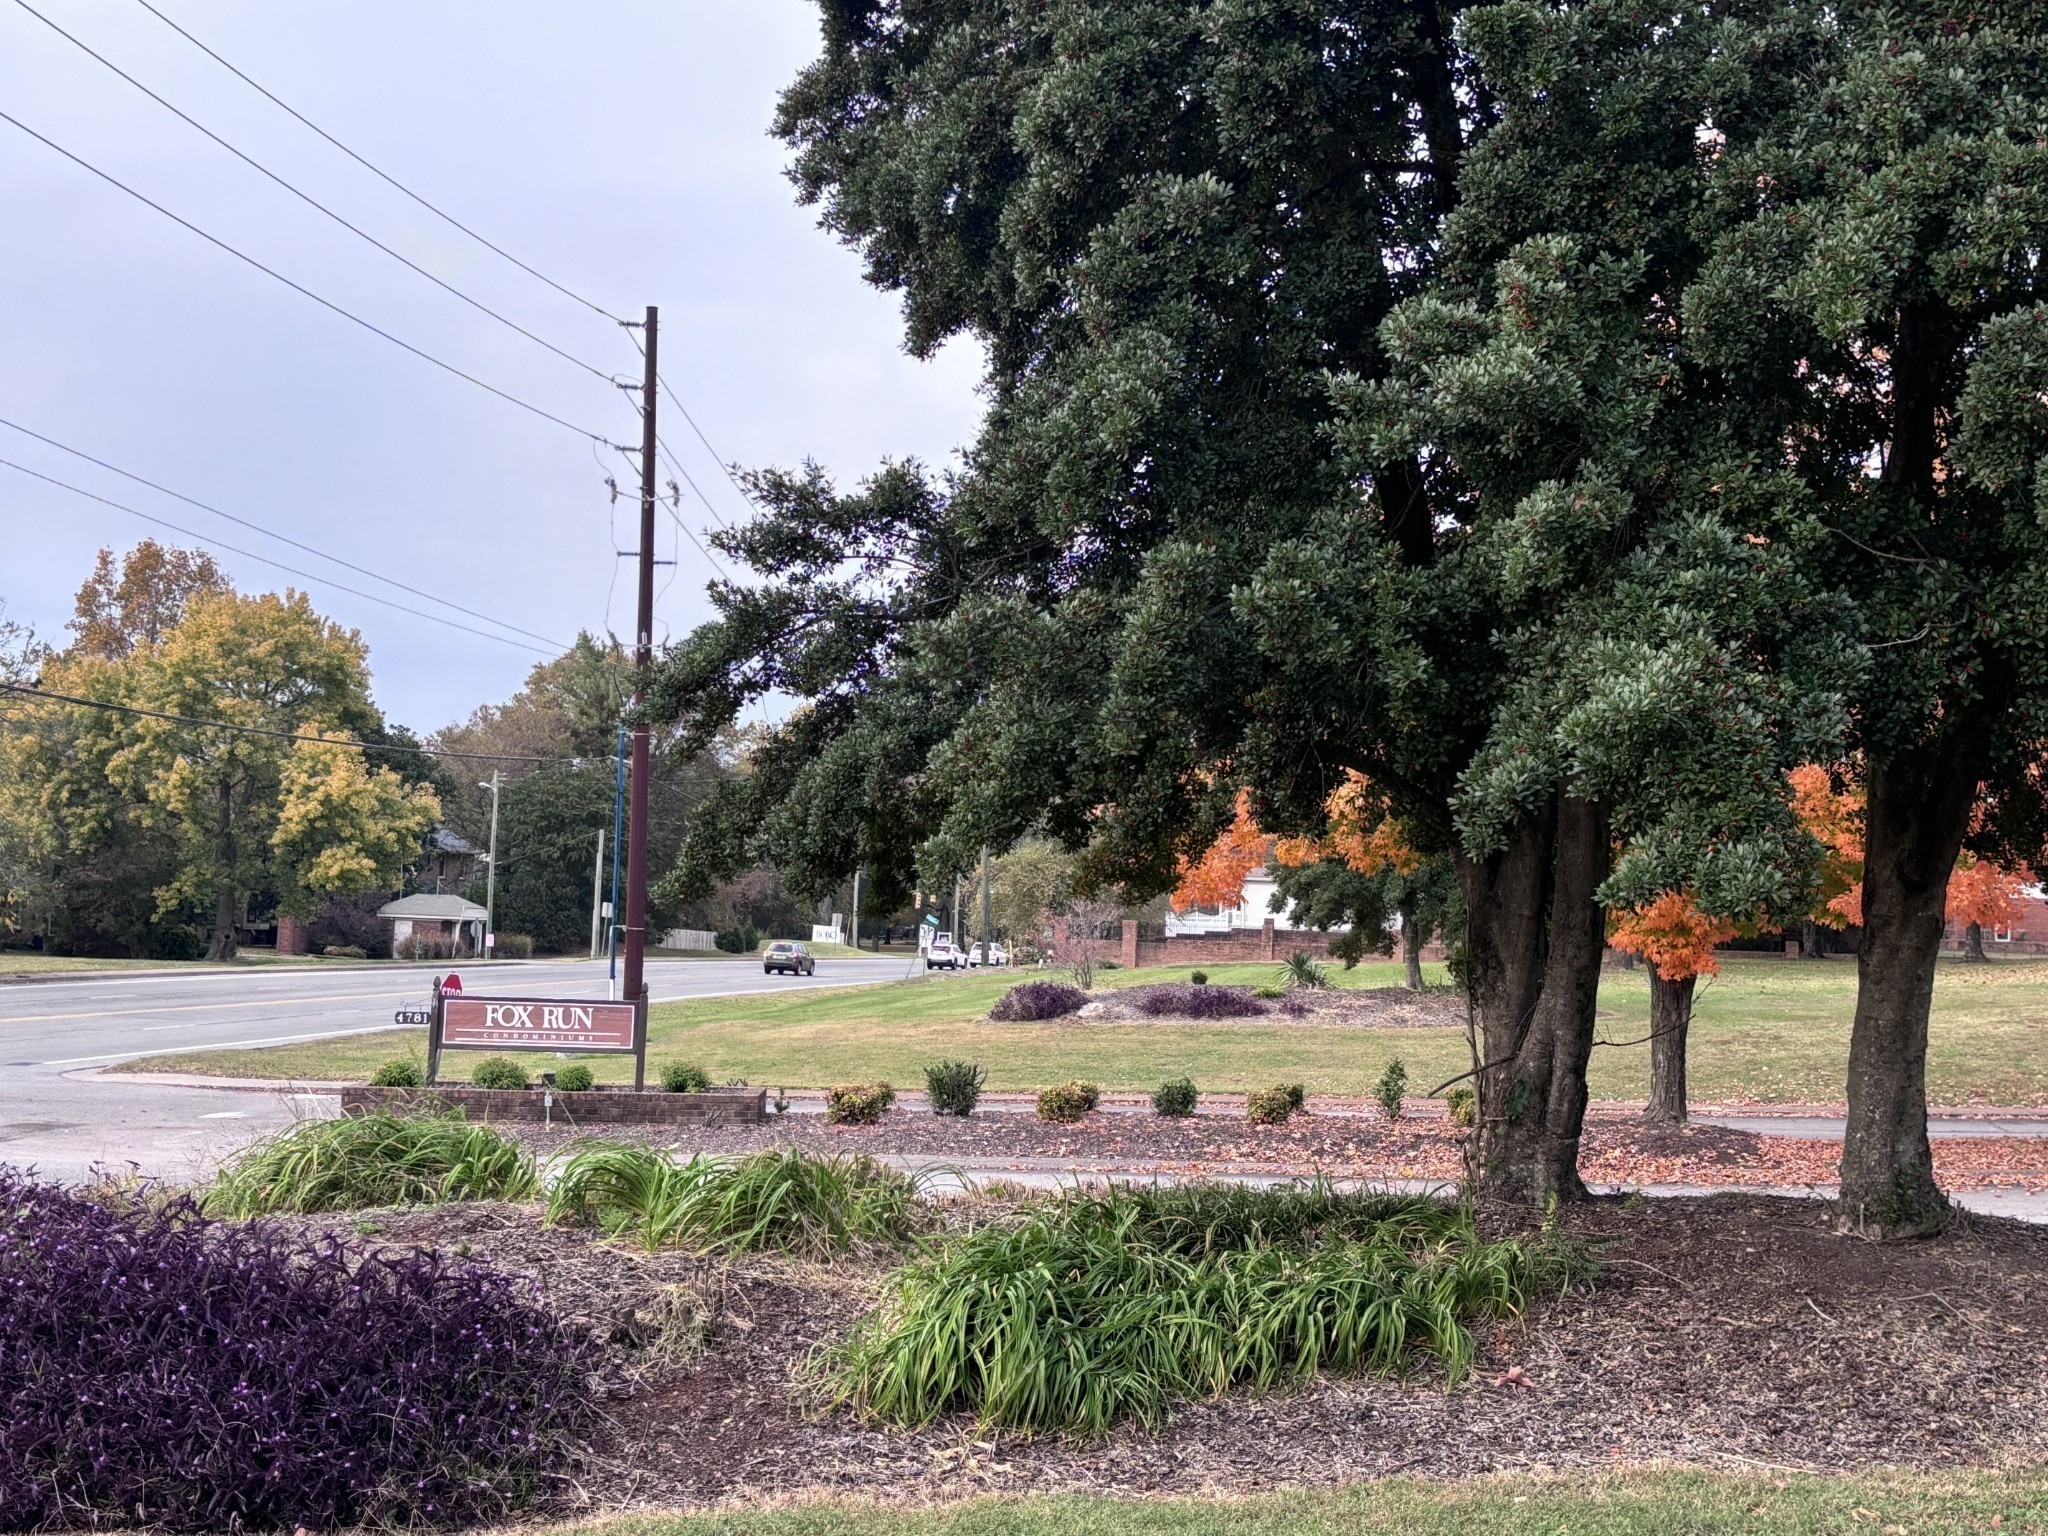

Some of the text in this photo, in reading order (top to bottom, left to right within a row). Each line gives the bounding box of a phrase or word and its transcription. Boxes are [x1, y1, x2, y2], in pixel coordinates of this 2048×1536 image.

[396, 1012, 428, 1023] 4781
[485, 1005, 594, 1029] FOX RUN
[483, 1032, 594, 1041] CONDOMINIUMS
